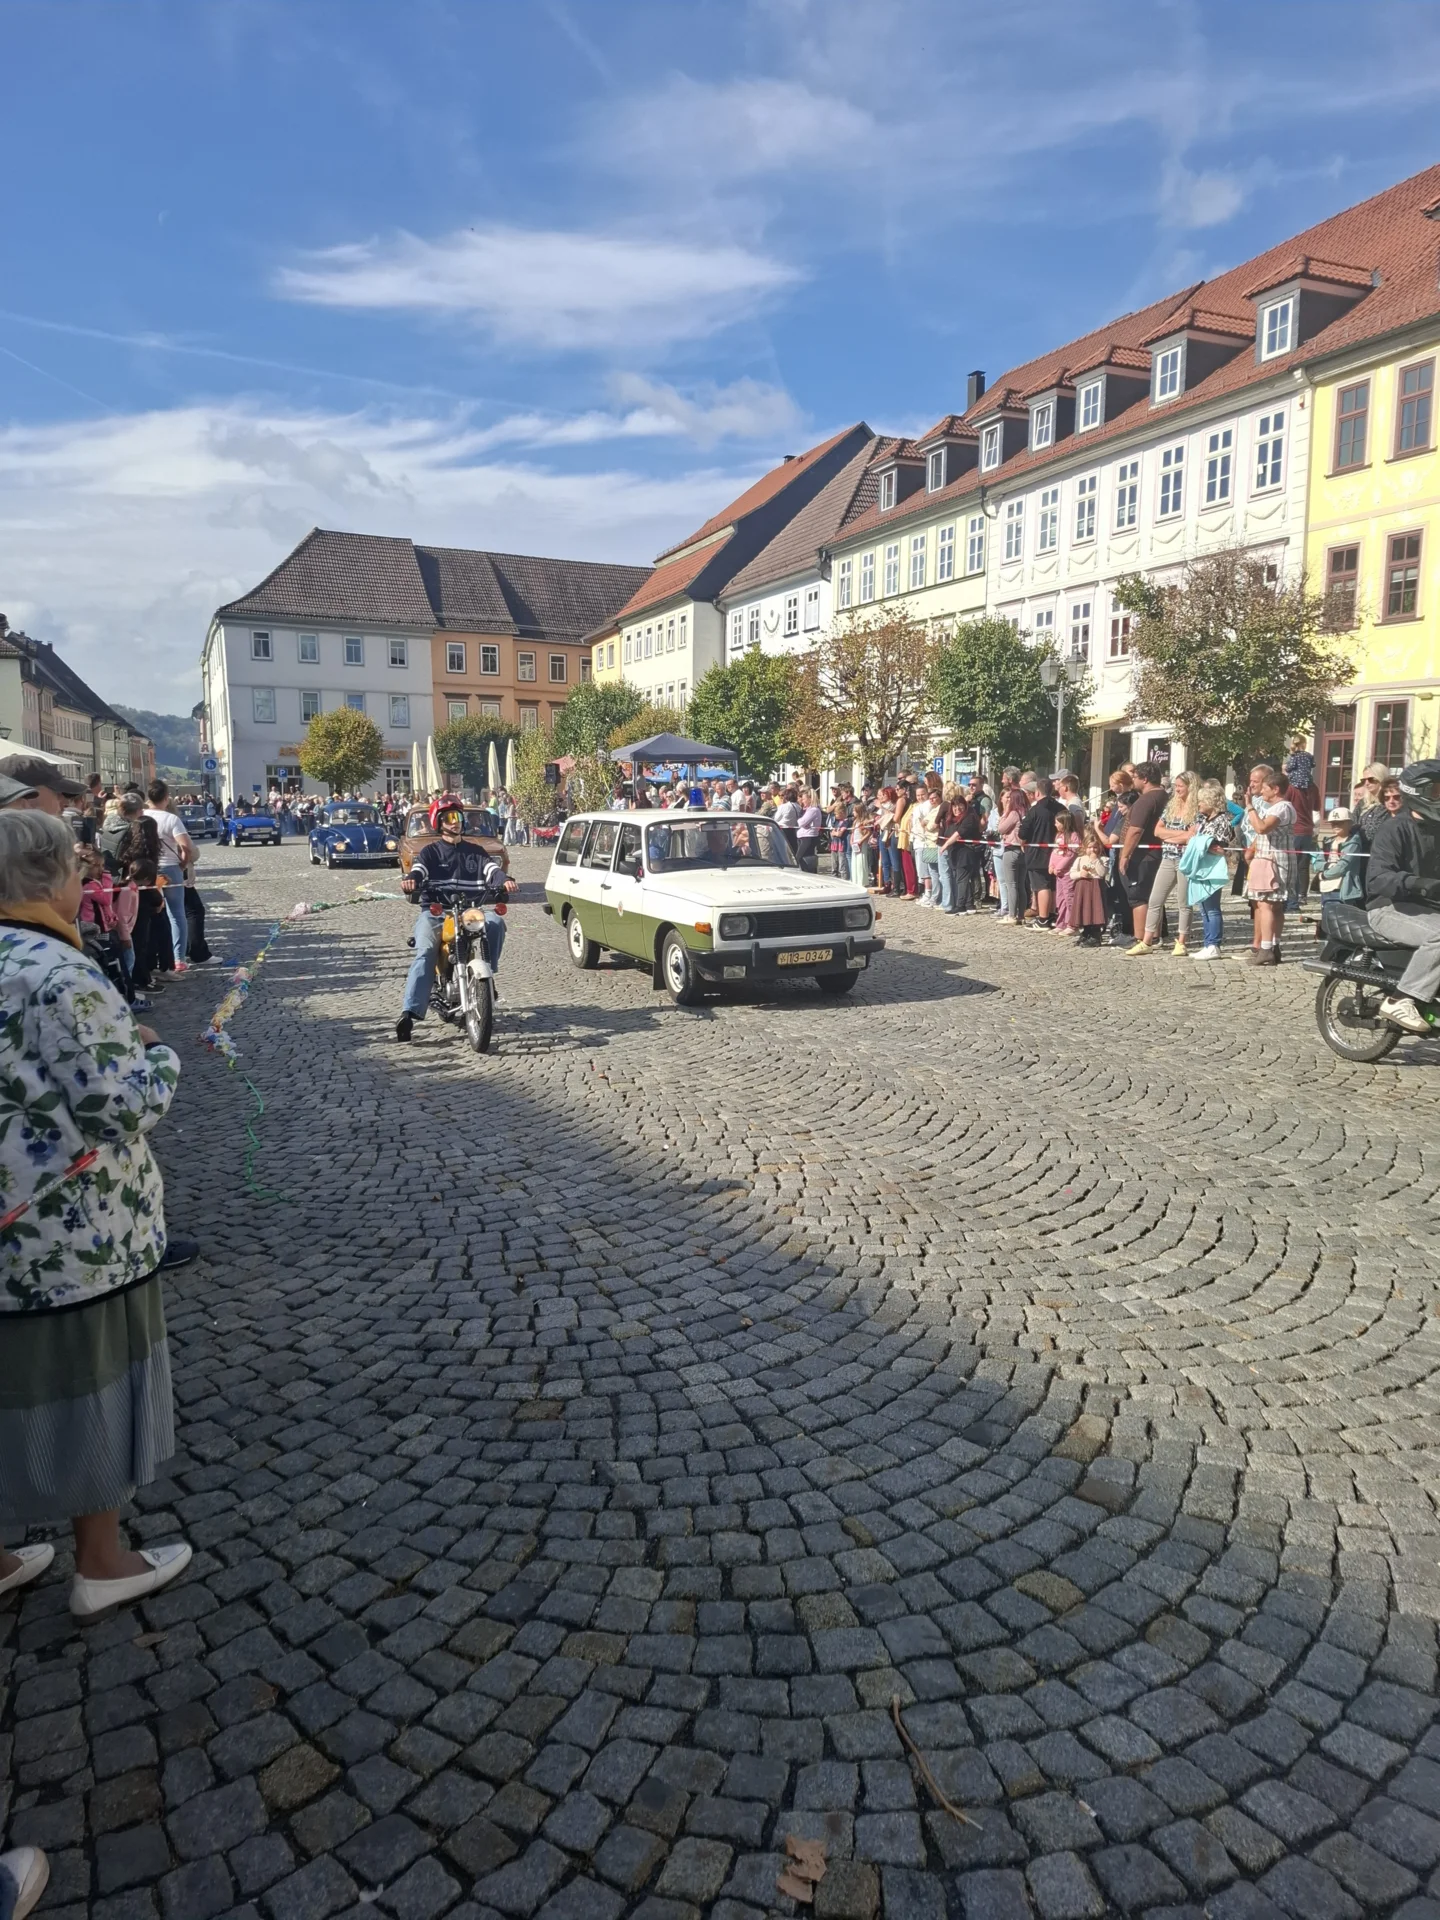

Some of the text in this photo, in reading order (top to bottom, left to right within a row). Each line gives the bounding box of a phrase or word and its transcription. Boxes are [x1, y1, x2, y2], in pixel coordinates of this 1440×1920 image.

[936, 759, 942, 771] P
[279, 768, 286, 777] P
[788, 950, 831, 963] 13-0347
